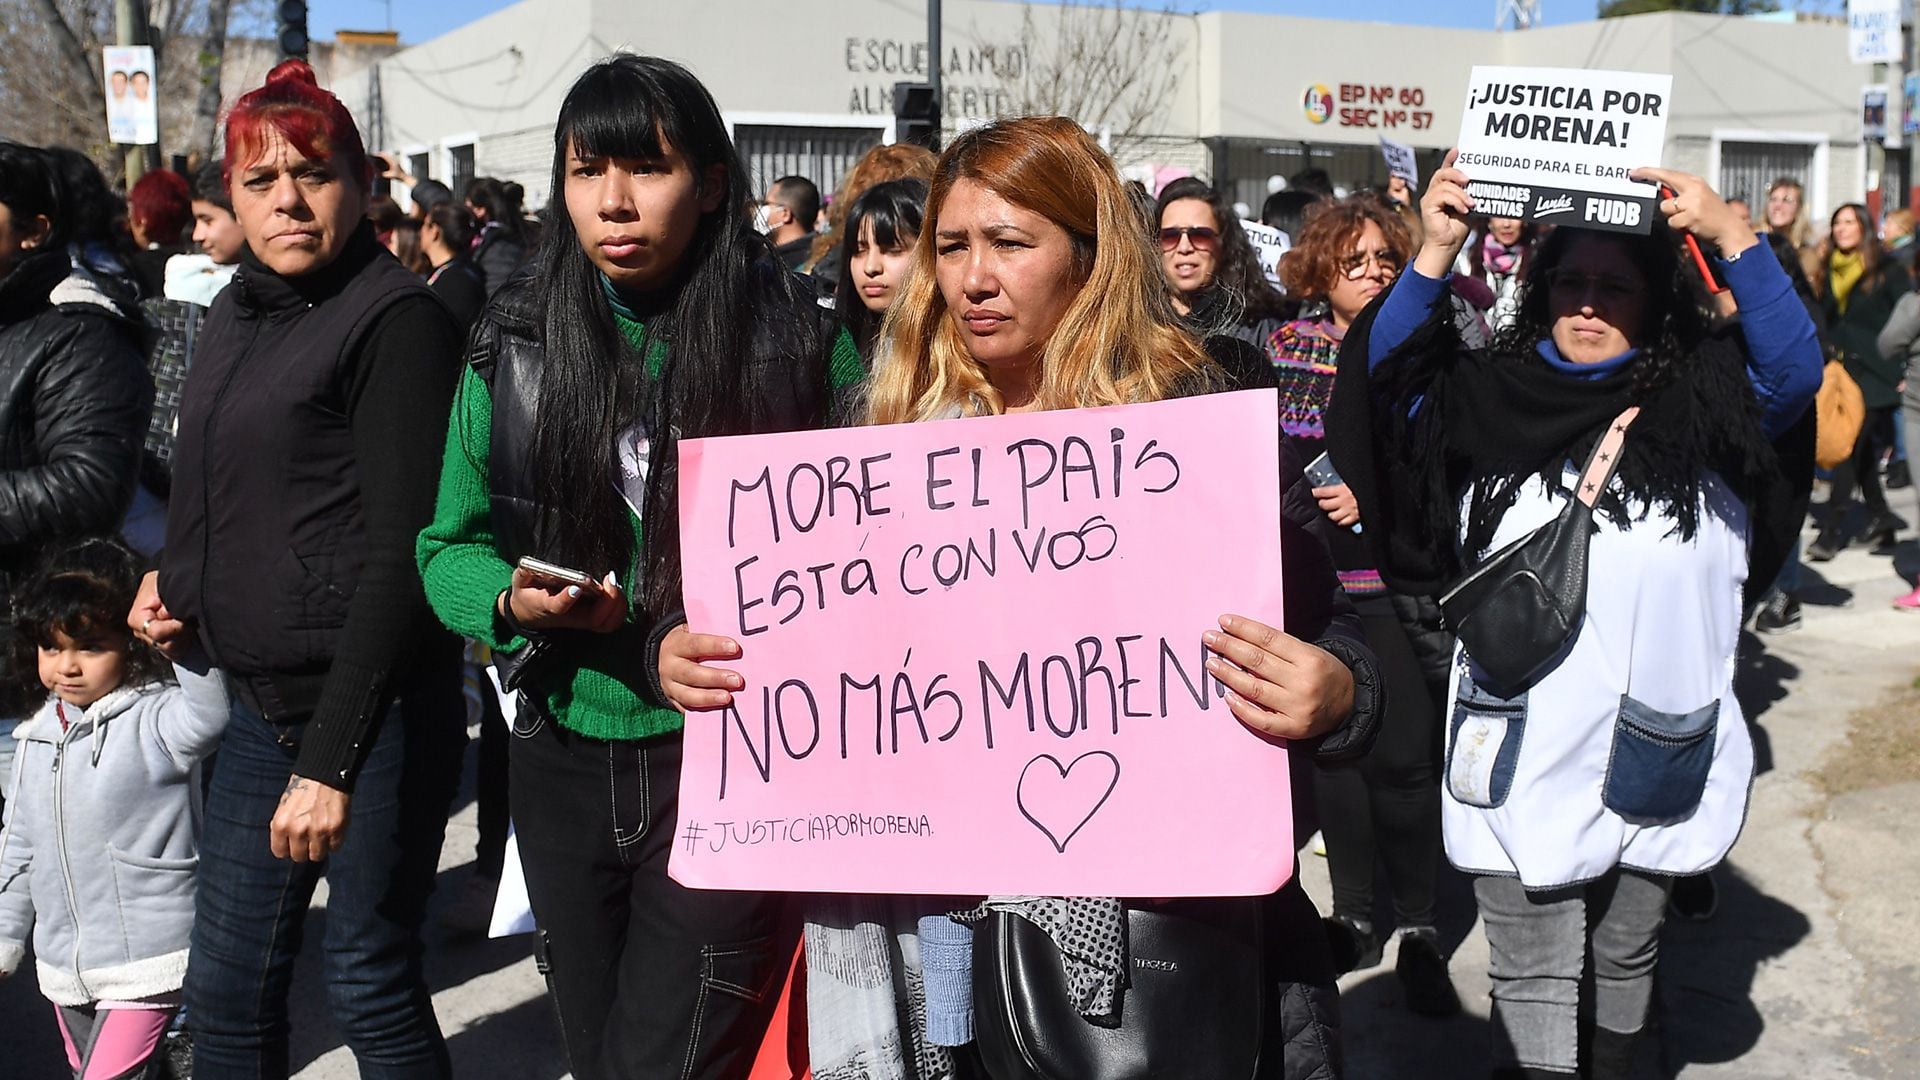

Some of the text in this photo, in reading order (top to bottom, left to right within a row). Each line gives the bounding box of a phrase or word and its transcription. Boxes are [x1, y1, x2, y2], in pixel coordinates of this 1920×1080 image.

[846, 37, 963, 77] ESCUEA
[1340, 84, 1366, 102] EP
[1399, 88, 1424, 106] 60
[1469, 83, 1662, 117] ¡JUSTICIA POR
[1340, 108, 1378, 127] SEC
[1411, 112, 1433, 129] 57
[1484, 112, 1630, 149] MORENA!
[1459, 153, 1530, 170] SEGURIDAD
[1534, 160, 1570, 174] PARA
[1575, 164, 1591, 176] EL
[1584, 197, 1641, 227] FUDB
[926, 446, 990, 511] EL
[900, 527, 997, 595] CON
[719, 636, 1227, 801] NO MÁS MOREN
